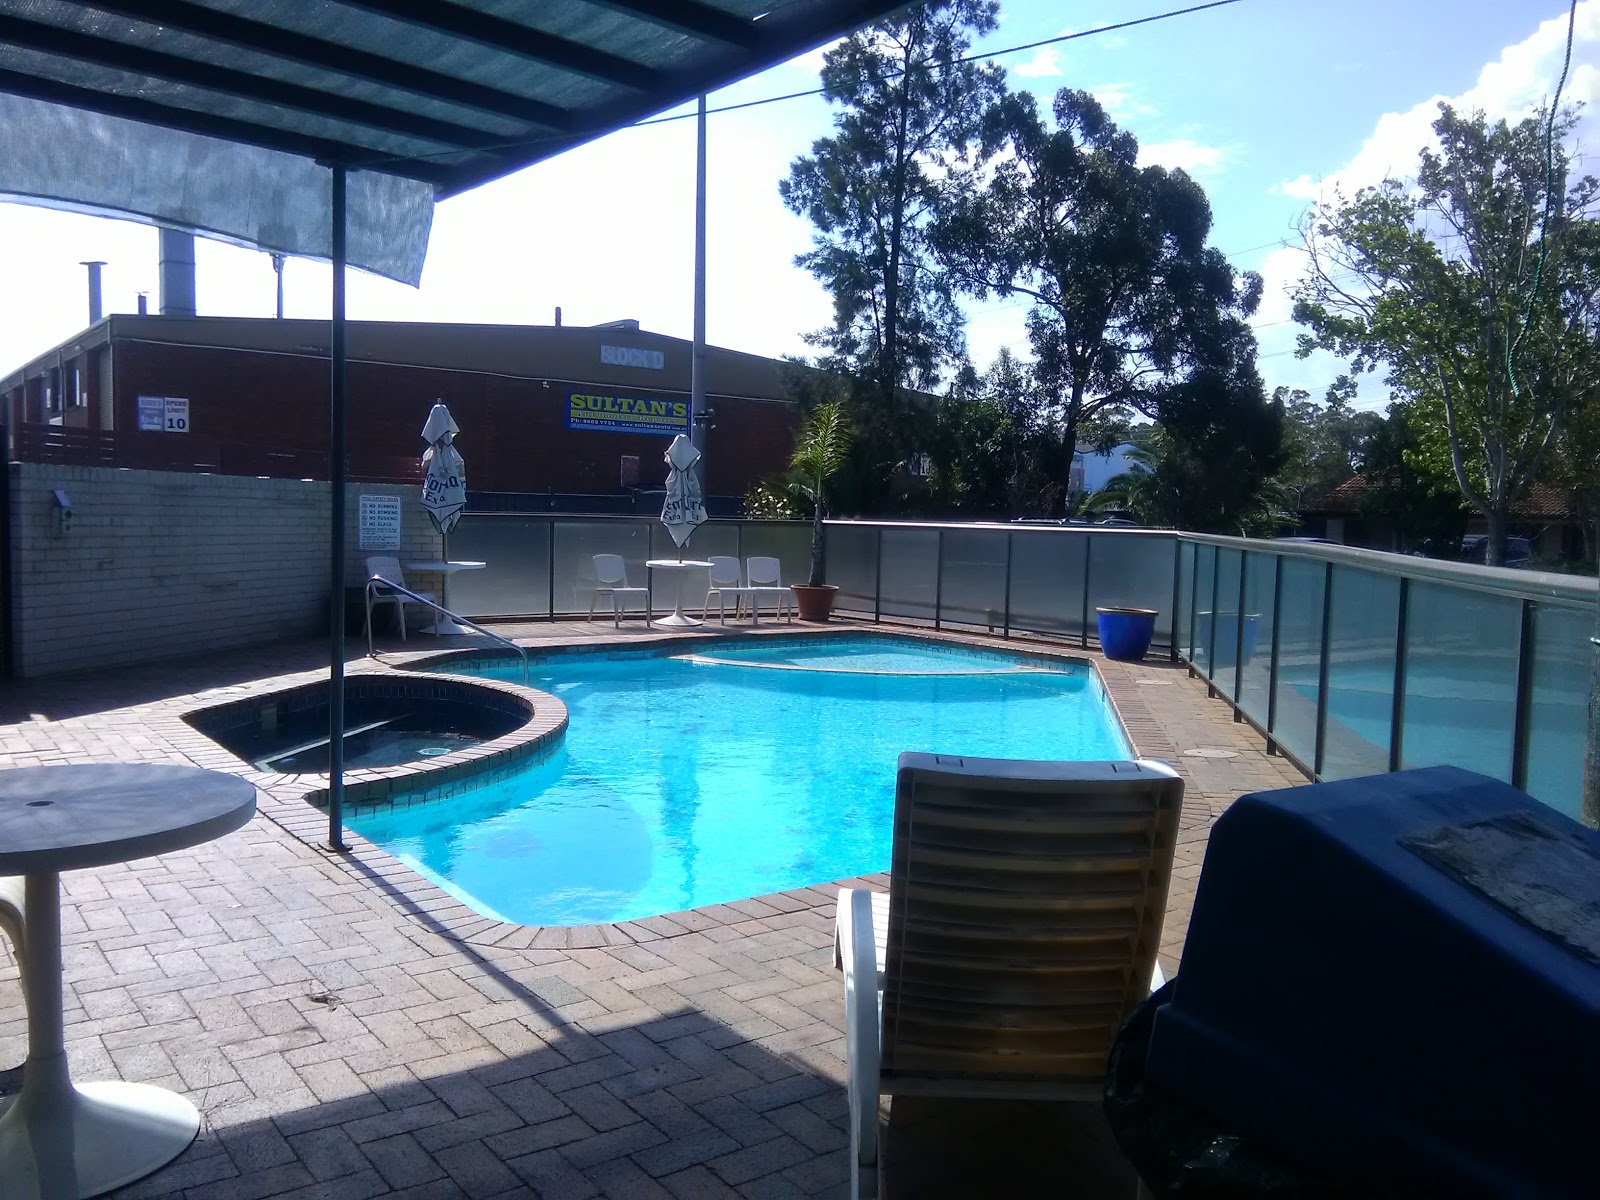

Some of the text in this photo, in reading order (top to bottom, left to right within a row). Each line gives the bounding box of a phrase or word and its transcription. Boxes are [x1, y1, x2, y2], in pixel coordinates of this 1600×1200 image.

[570, 394, 687, 417] SULTAN'S
[576, 410, 637, 420] Automotive
[167, 418, 186, 430] 10
